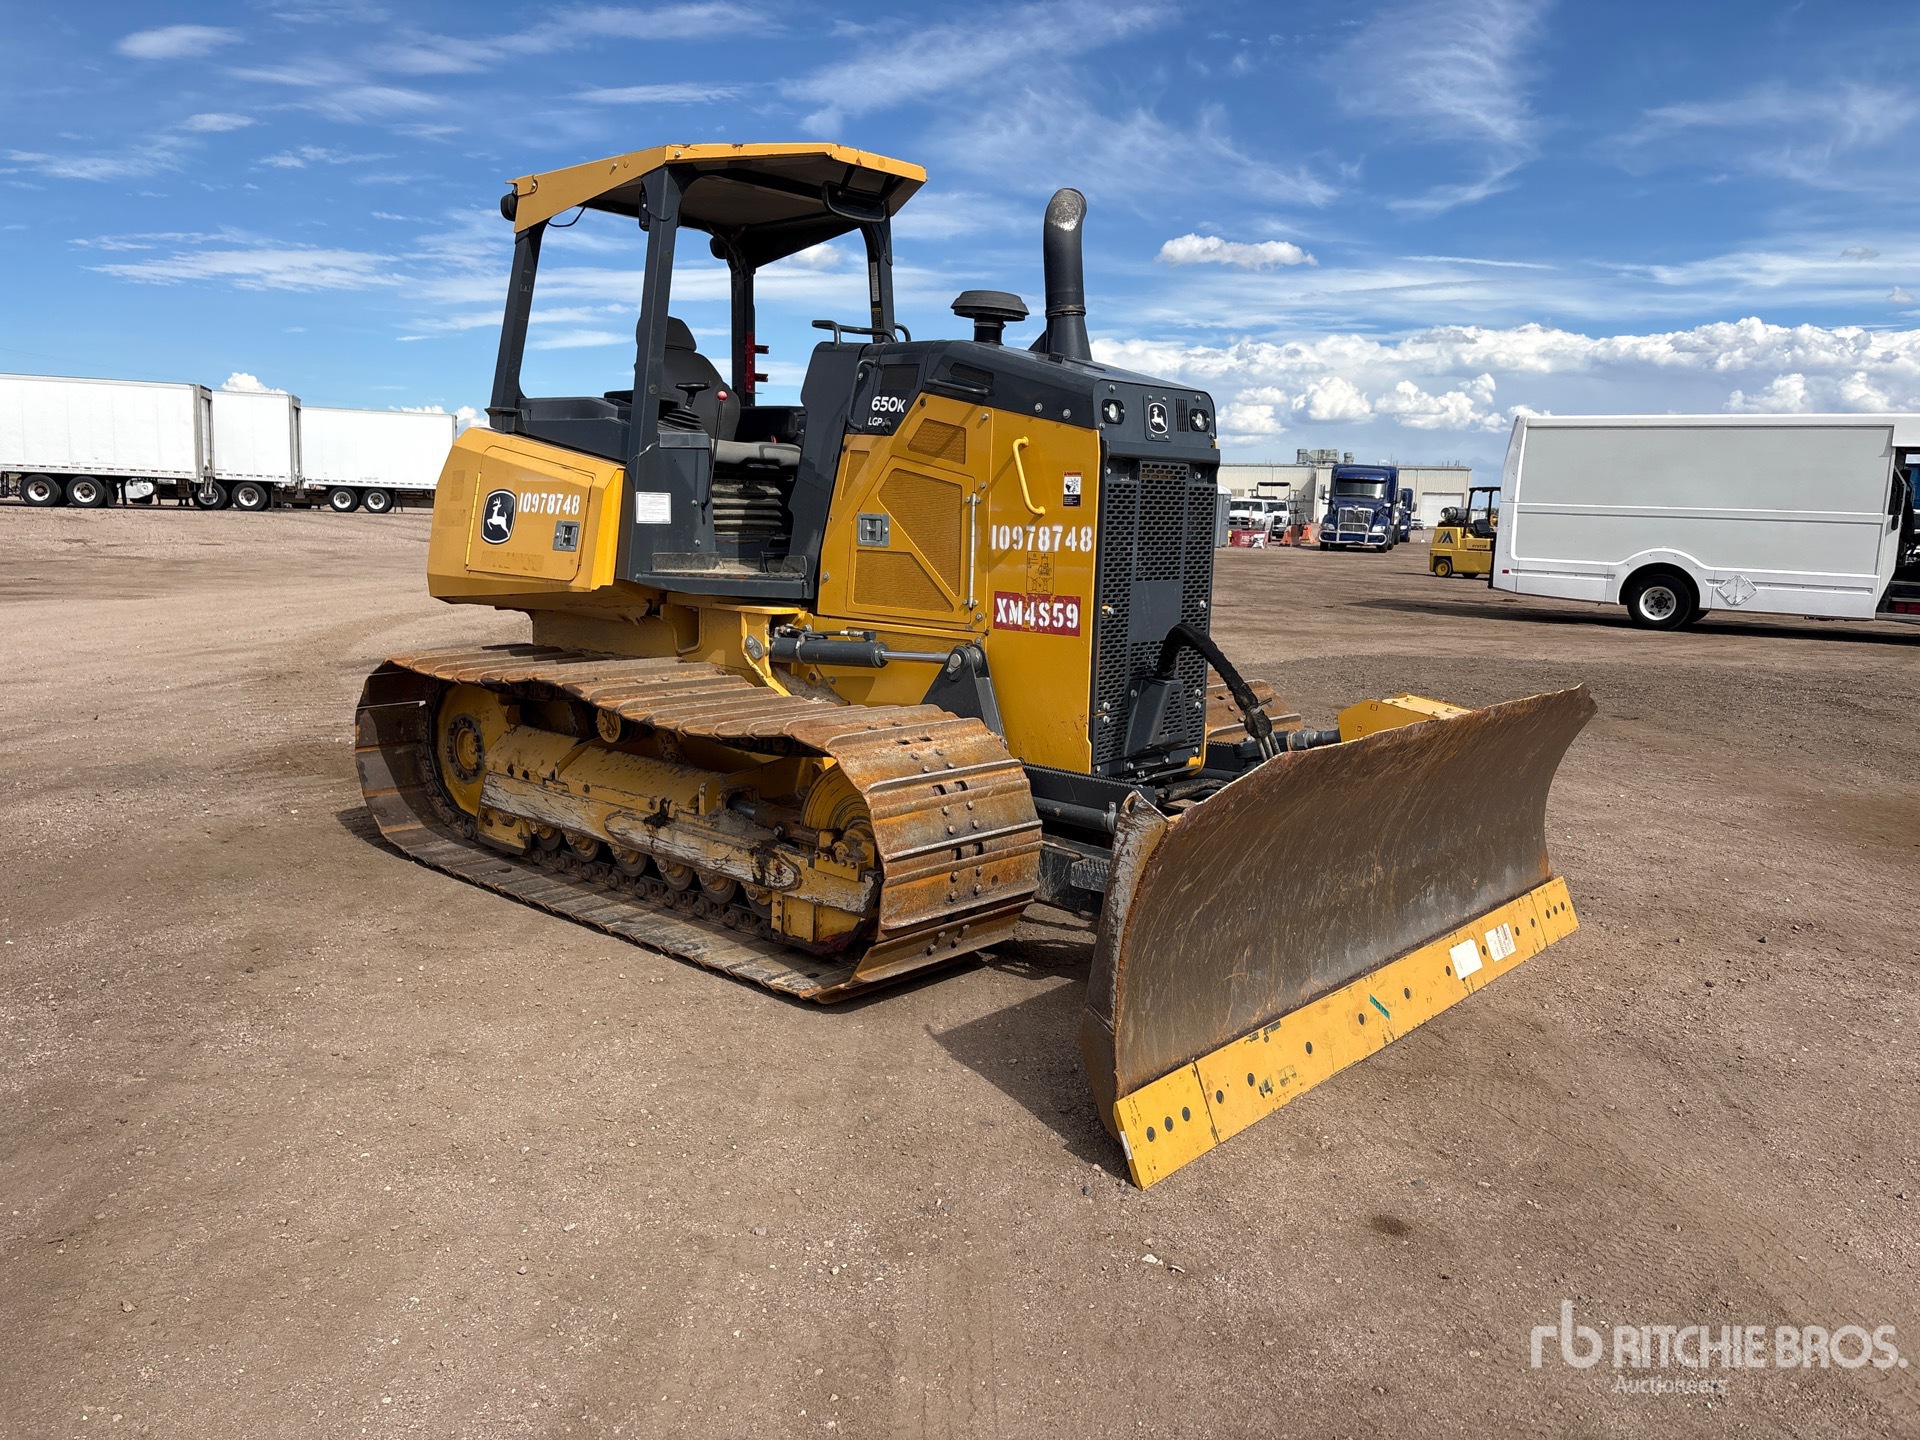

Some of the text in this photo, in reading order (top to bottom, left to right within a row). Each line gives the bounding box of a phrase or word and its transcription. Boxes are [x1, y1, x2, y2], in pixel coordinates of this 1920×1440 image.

[871, 395, 906, 413] 650K
[518, 492, 580, 516] 10978748
[991, 524, 1093, 552] 10978748
[996, 597, 1079, 628] XM4S59
